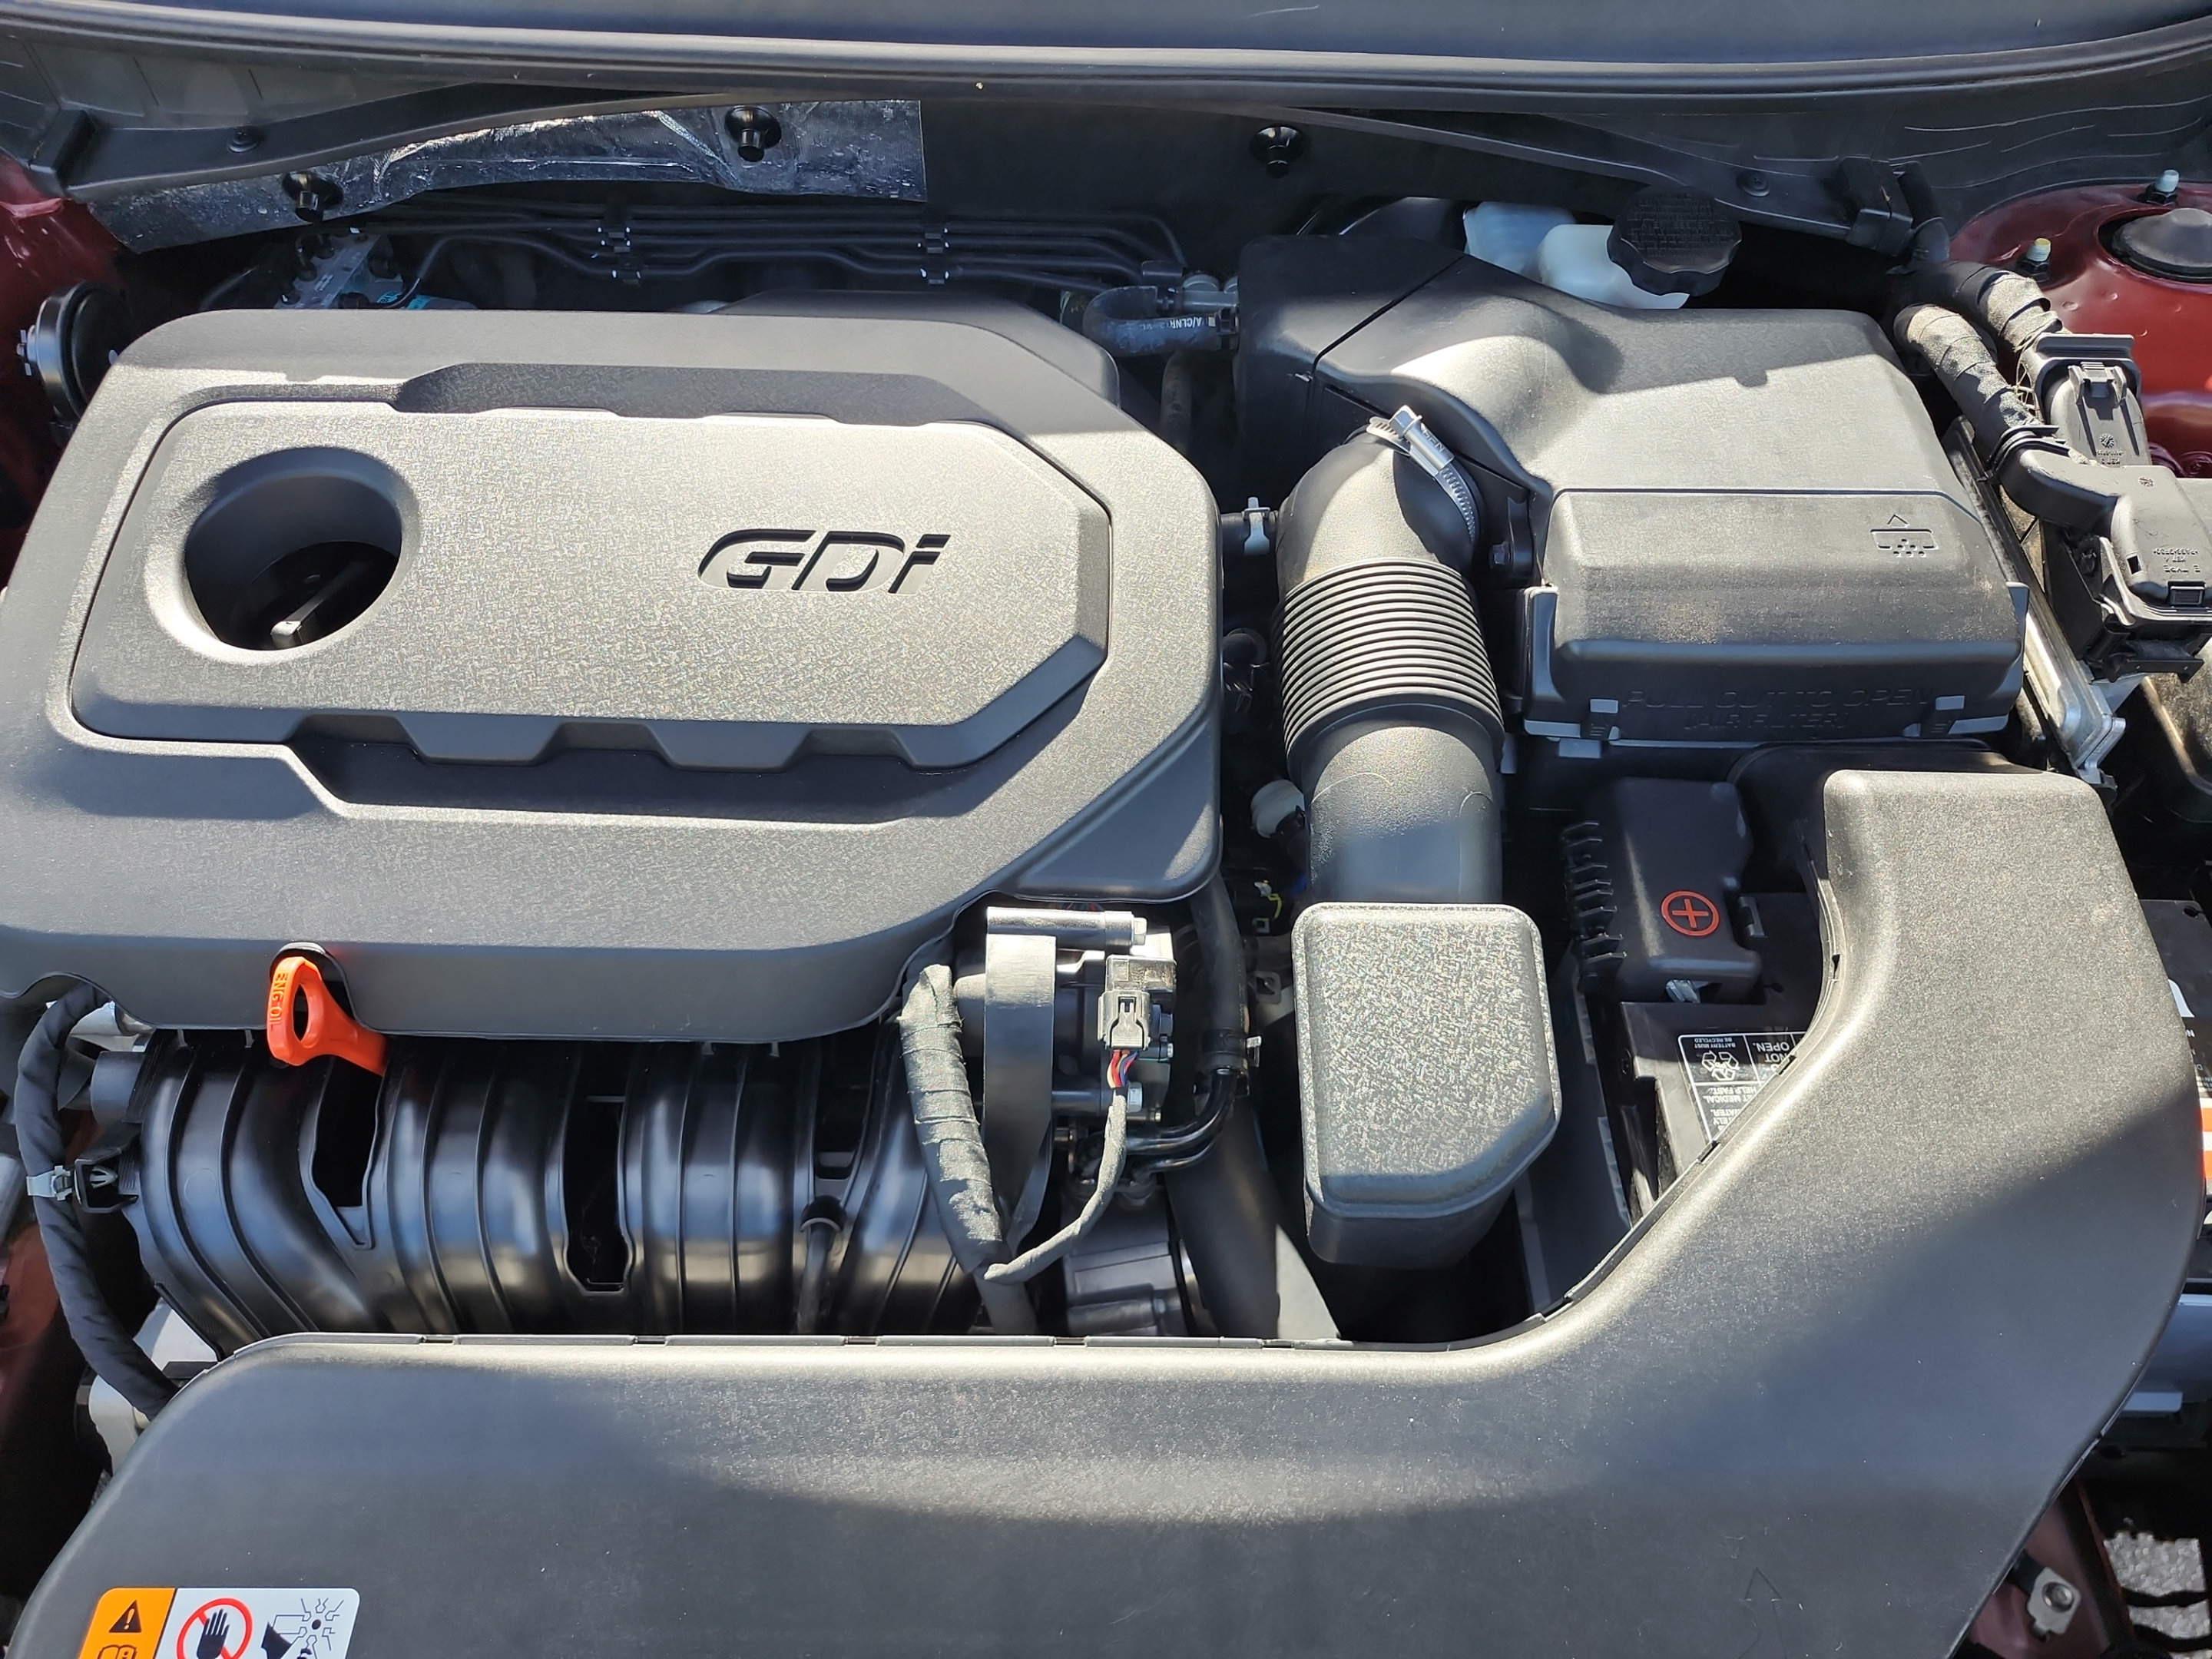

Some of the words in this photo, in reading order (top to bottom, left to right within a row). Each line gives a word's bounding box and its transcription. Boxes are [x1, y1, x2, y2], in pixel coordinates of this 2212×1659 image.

[1621, 690, 1707, 709] PULL
[1714, 690, 1788, 708] OUT
[1795, 690, 1833, 708] TO
[1843, 688, 1928, 707] OPEN
[1753, 1042, 1790, 1052] OPEN.
[1736, 1086, 1757, 1094] HELP
[1703, 1094, 1741, 1104] MEDICAL
